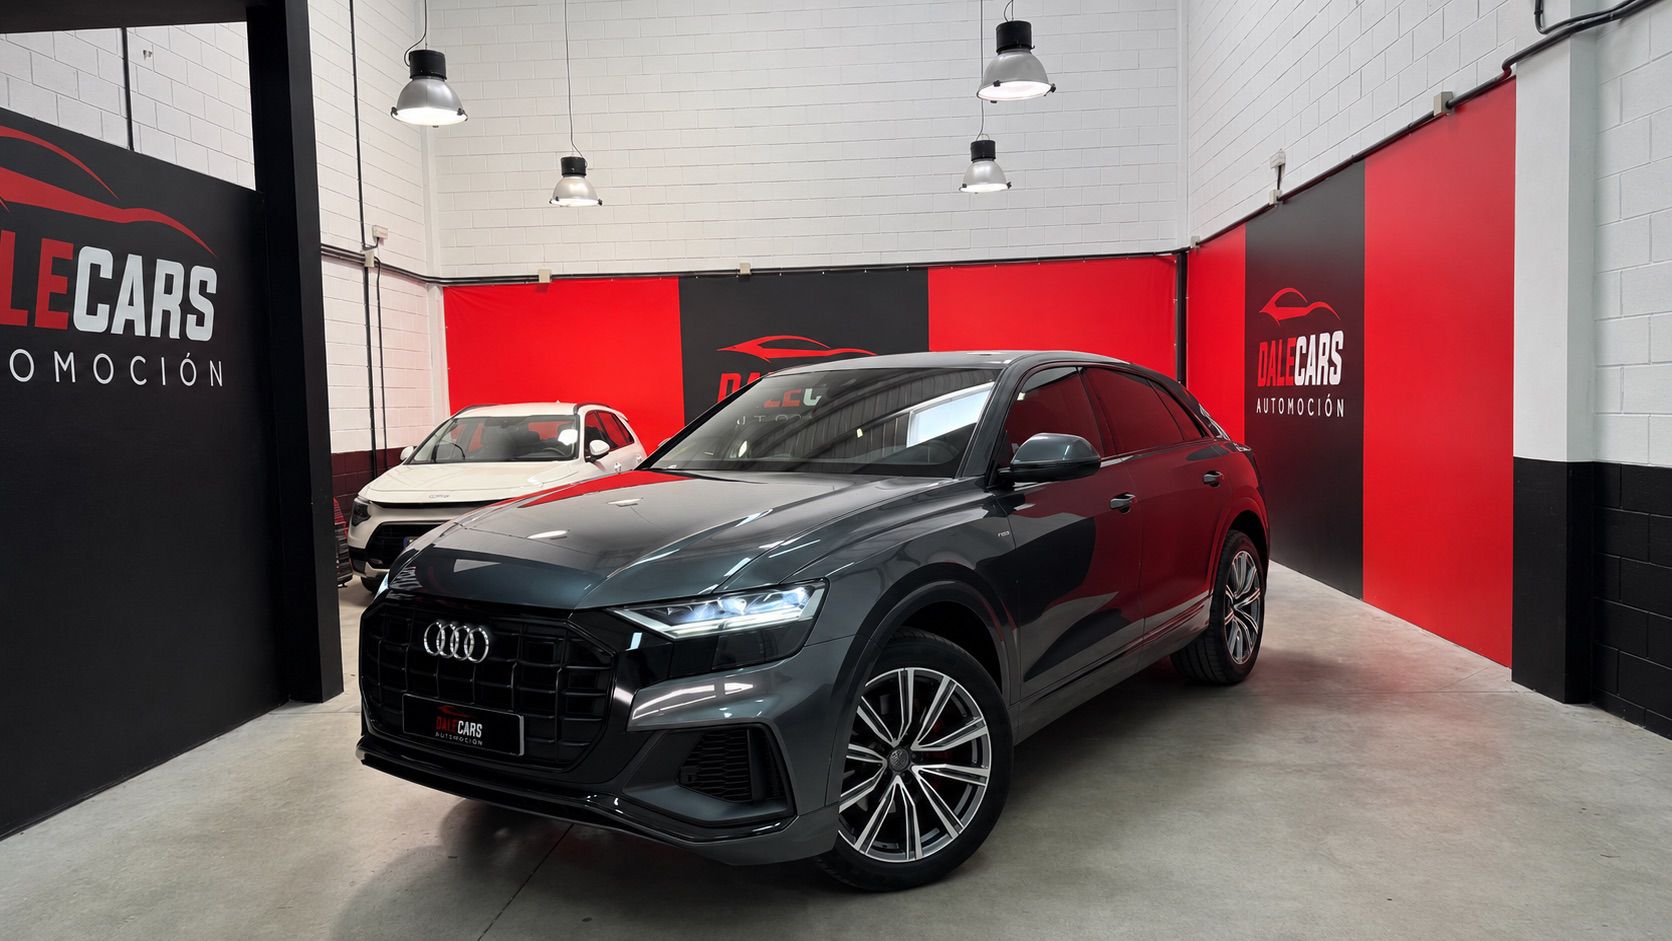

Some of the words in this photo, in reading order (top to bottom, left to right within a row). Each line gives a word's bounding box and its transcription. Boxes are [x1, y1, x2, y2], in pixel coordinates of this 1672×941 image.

[0, 230, 217, 342] LECARS
[9, 348, 223, 387] OMOCIÓN
[1257, 330, 1344, 387] DALECARS
[1256, 393, 1344, 417] AUTOMOCIÓN
[436, 716, 482, 738] DALECARS
